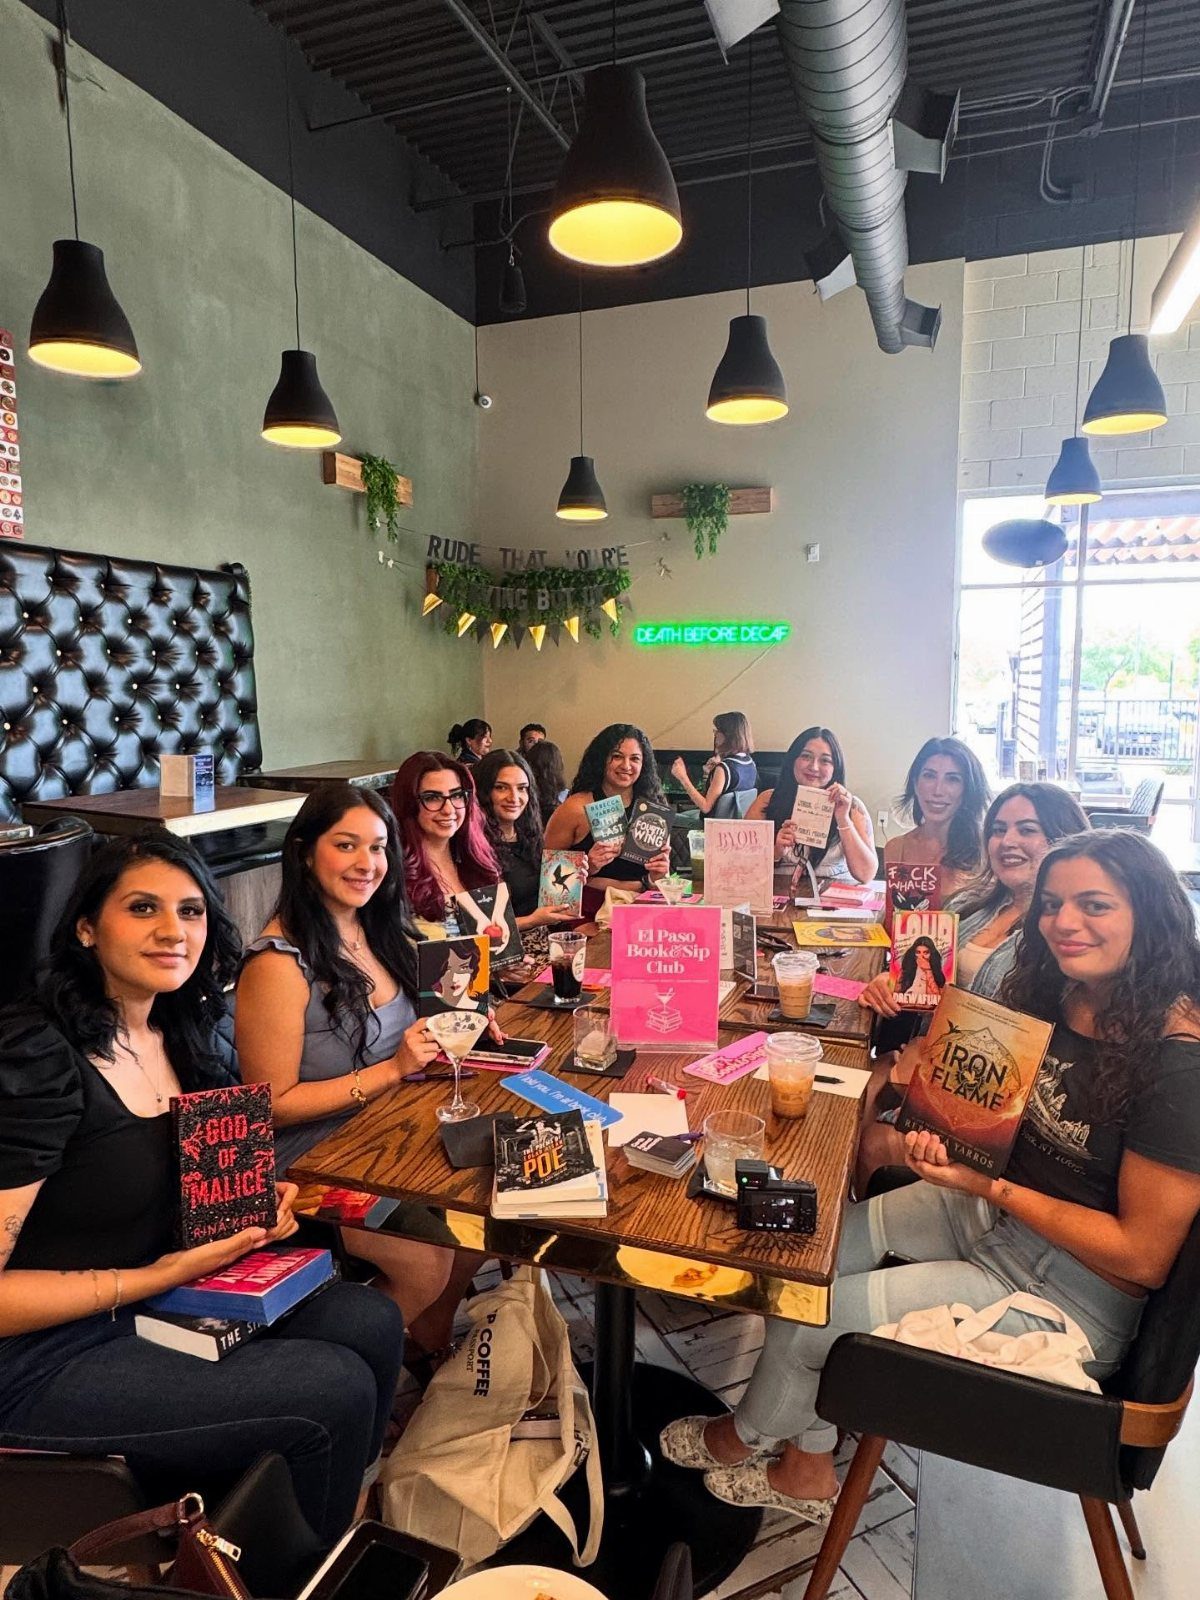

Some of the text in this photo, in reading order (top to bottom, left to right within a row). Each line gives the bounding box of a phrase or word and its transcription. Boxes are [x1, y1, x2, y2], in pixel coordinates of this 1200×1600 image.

[427, 534, 482, 565] RUDE
[499, 547, 548, 569] THAT
[636, 625, 789, 643] DEATH BEFORE DECAF
[599, 823, 624, 838] LAST
[634, 827, 664, 848] WING
[635, 820, 667, 837] FOURTH
[718, 830, 758, 848] BYOB
[888, 879, 936, 892] WHALES
[639, 929, 696, 943] El Paso
[895, 912, 954, 938] LOUD
[646, 961, 685, 974] Club
[941, 1042, 1008, 1088] IRON
[931, 1066, 1004, 1111] FLAME
[205, 1113, 248, 1145] GOD
[218, 1145, 239, 1169] OF
[523, 1144, 568, 1179] POE
[954, 1142, 995, 1169] YARROS
[190, 1166, 268, 1210] MALICE
[193, 1210, 269, 1238] RINA KENT
[220, 1327, 242, 1350] THE
[473, 1328, 493, 1397] COFFEE
